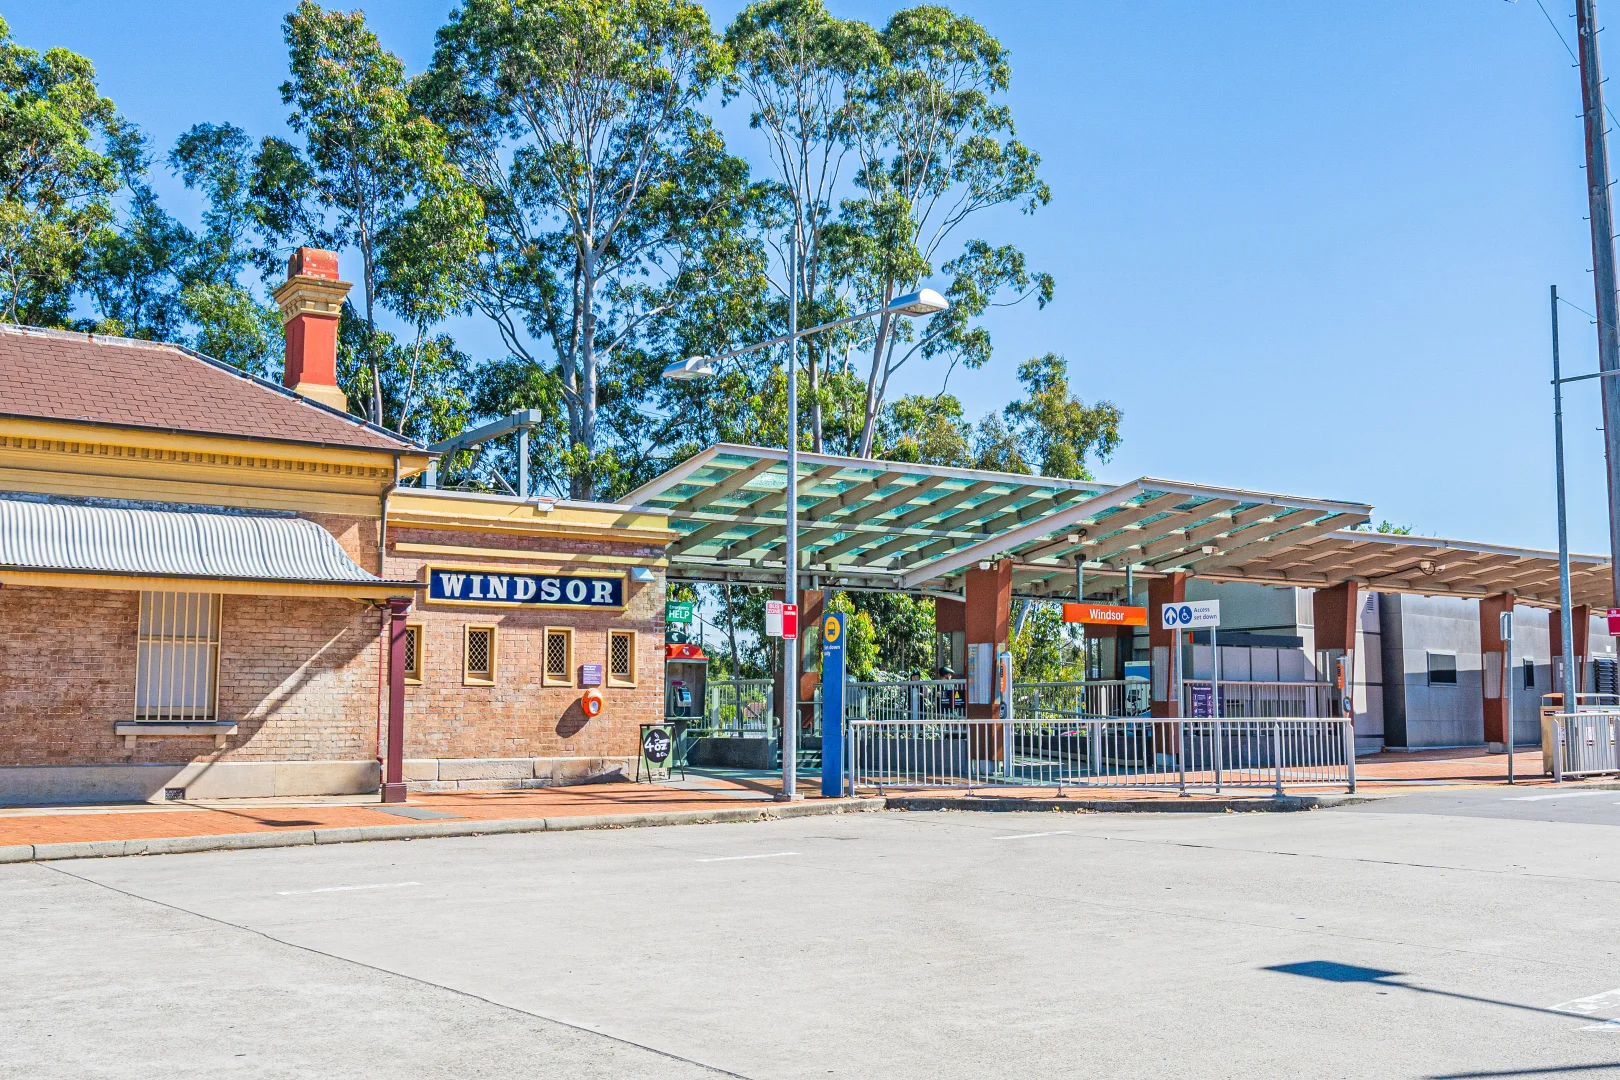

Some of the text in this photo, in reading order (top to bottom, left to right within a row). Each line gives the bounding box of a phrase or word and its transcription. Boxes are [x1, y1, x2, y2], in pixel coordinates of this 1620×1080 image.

[439, 573, 613, 604] WINDSOR
[668, 610, 690, 619] HELP
[1089, 608, 1125, 621] Windsor
